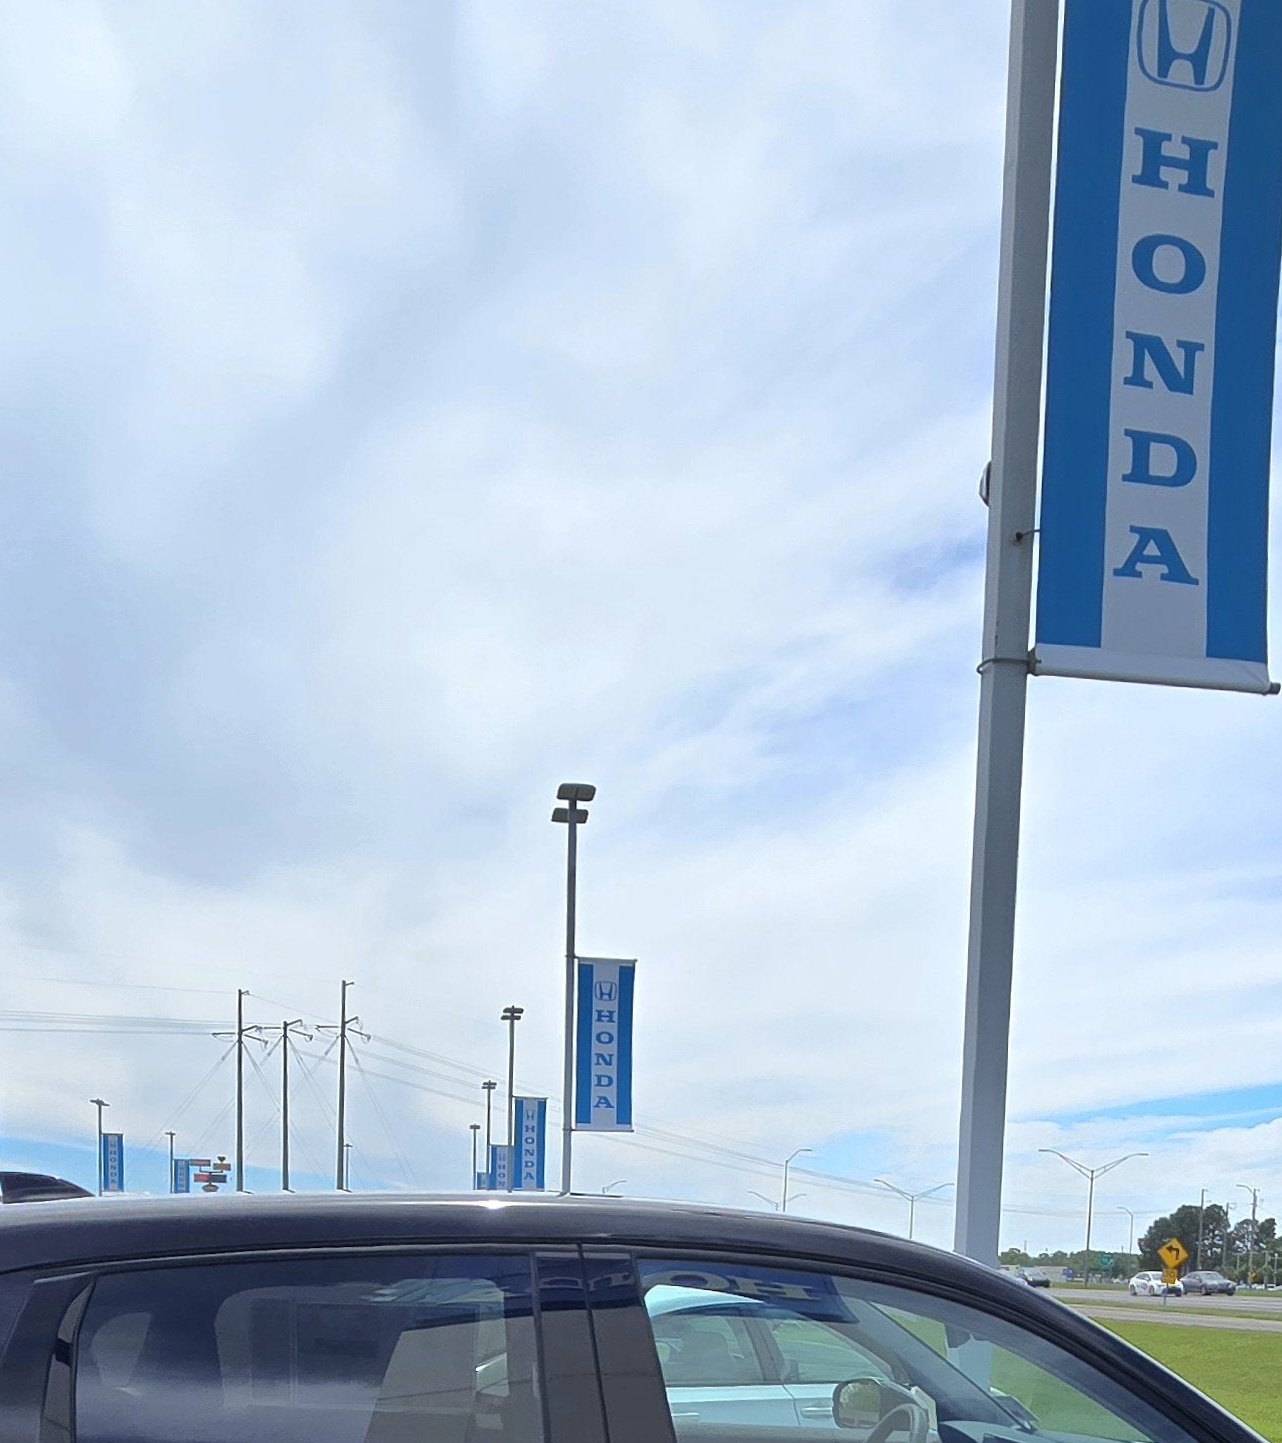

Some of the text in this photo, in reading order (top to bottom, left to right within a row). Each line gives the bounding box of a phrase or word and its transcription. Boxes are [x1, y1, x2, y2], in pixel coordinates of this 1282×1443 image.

[1113, 126, 1219, 586] HONDA
[593, 1009, 617, 1109] HONDA
[523, 1125, 535, 1180] HONDA
